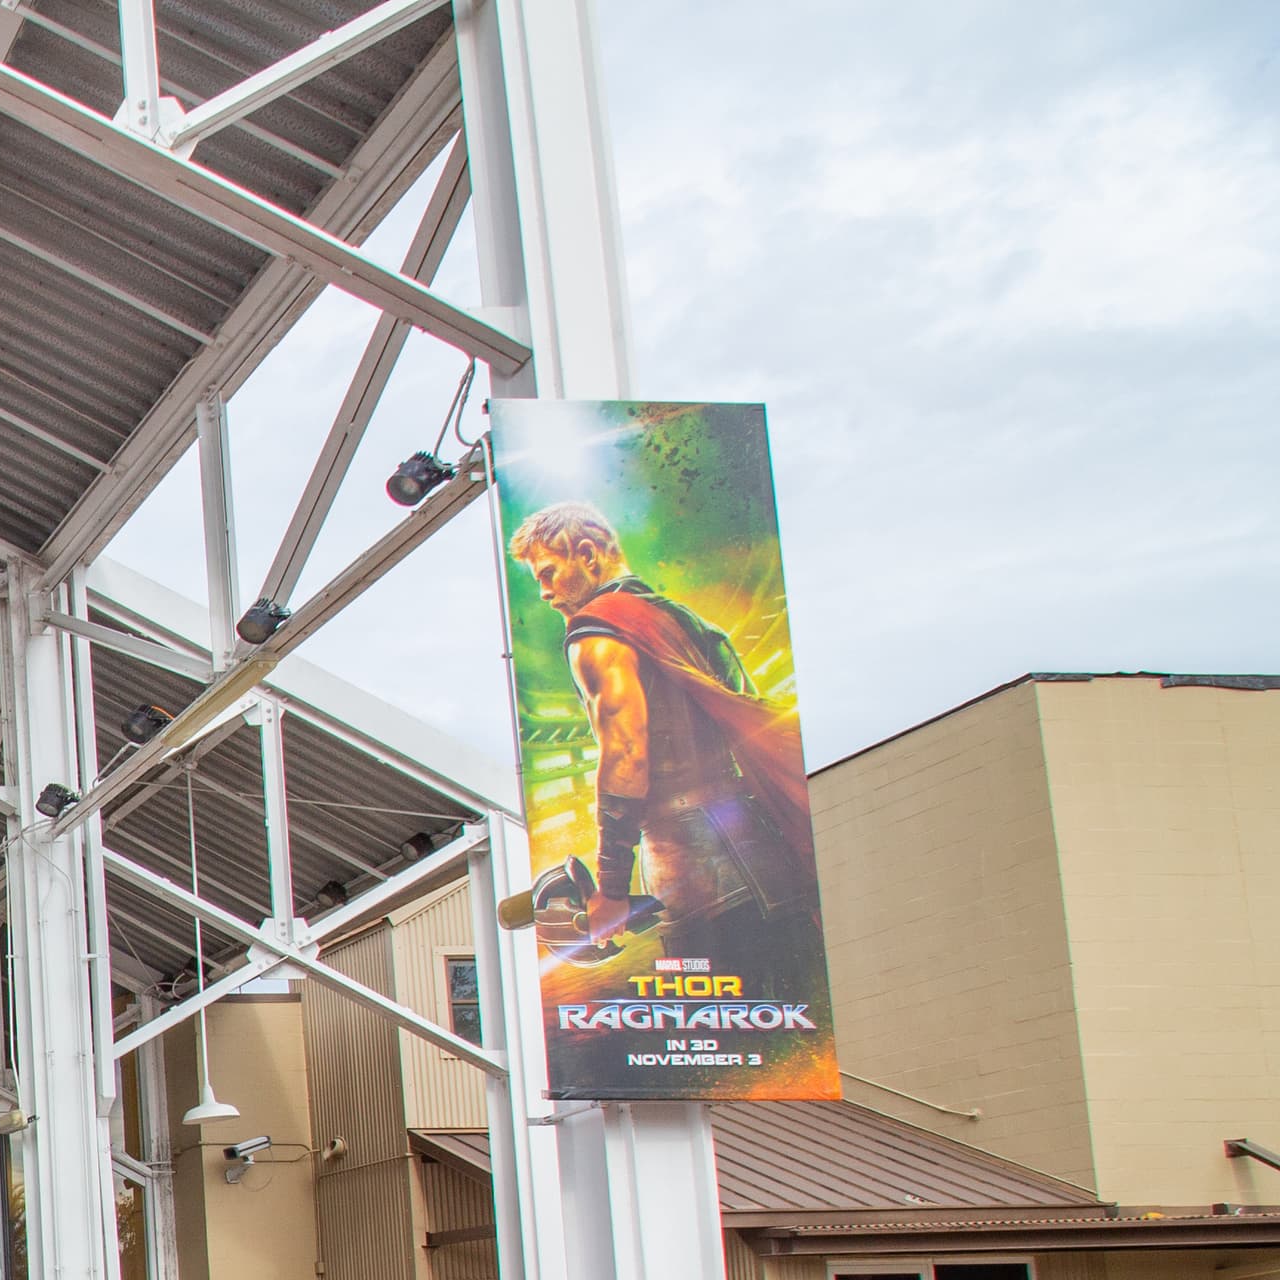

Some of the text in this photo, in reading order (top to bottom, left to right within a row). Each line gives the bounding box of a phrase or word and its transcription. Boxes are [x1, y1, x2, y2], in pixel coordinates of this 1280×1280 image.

[655, 958, 710, 972] MARVEL STUDIOS
[628, 976, 743, 997] THOR
[558, 1004, 817, 1030] RAGNAROK
[666, 1040, 718, 1051] IN 3D
[628, 1054, 762, 1066] NOVEMBER 3
